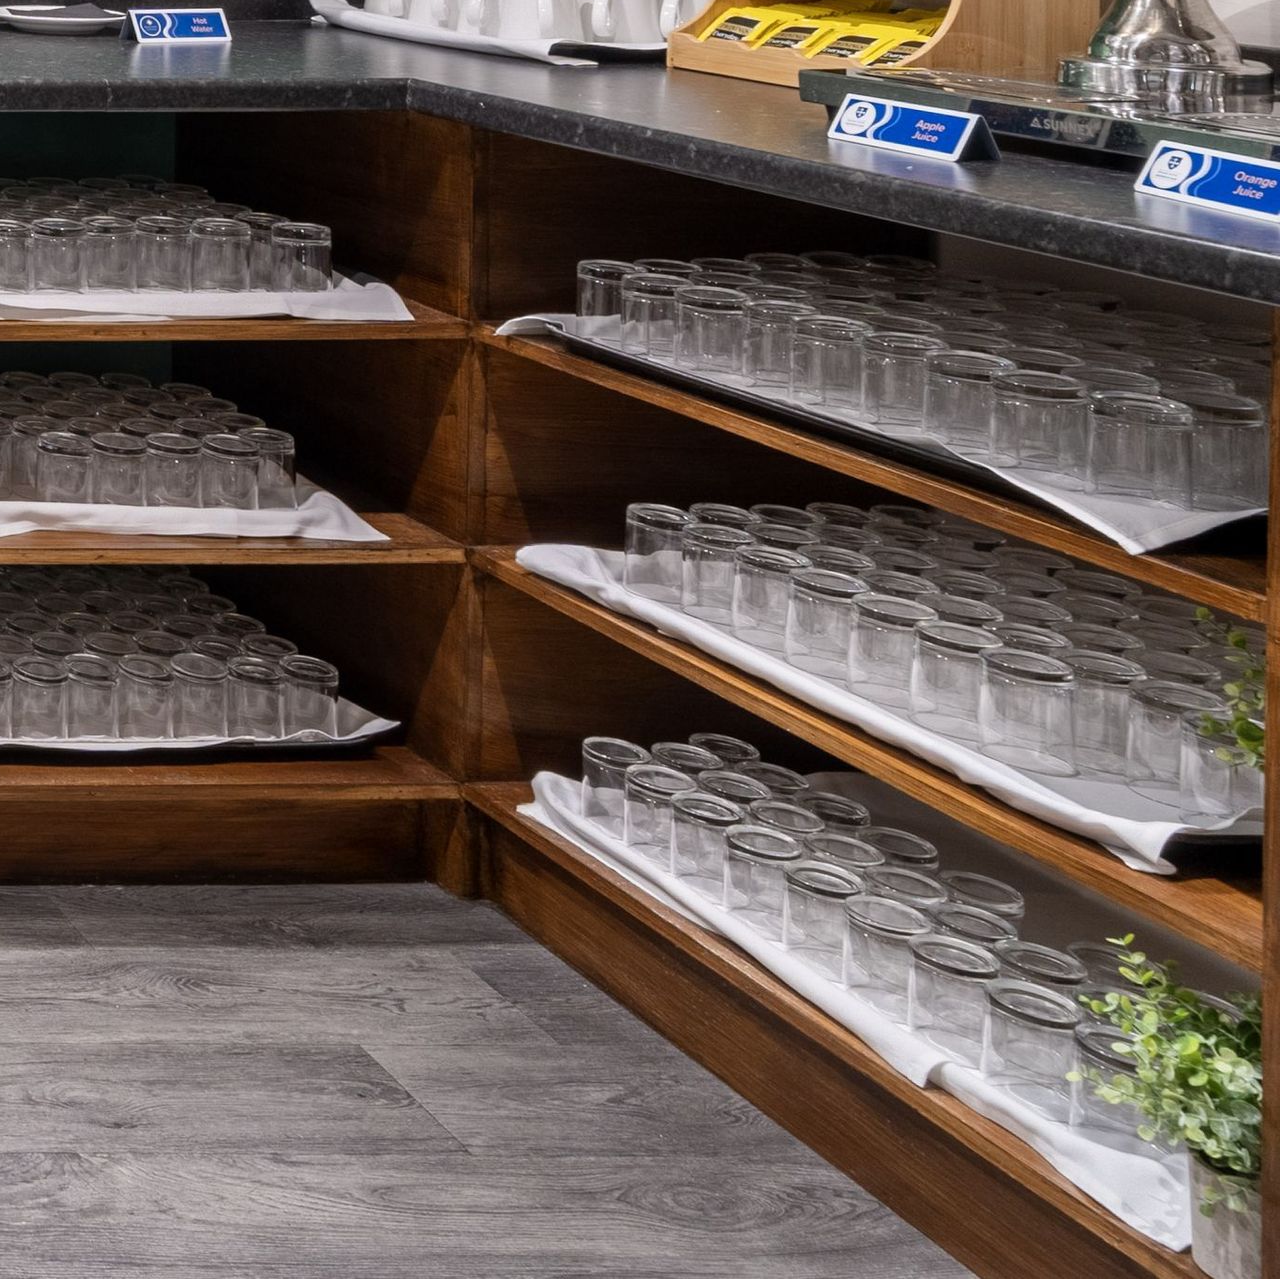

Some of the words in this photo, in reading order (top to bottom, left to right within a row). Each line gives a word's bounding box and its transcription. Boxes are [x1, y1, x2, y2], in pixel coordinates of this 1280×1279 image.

[191, 25, 213, 33] Water
[915, 120, 946, 132] Apple
[1043, 118, 1096, 138] SUNNEX
[911, 131, 939, 143] Juice
[1234, 171, 1277, 189] Orange
[1232, 185, 1264, 200] Juice
